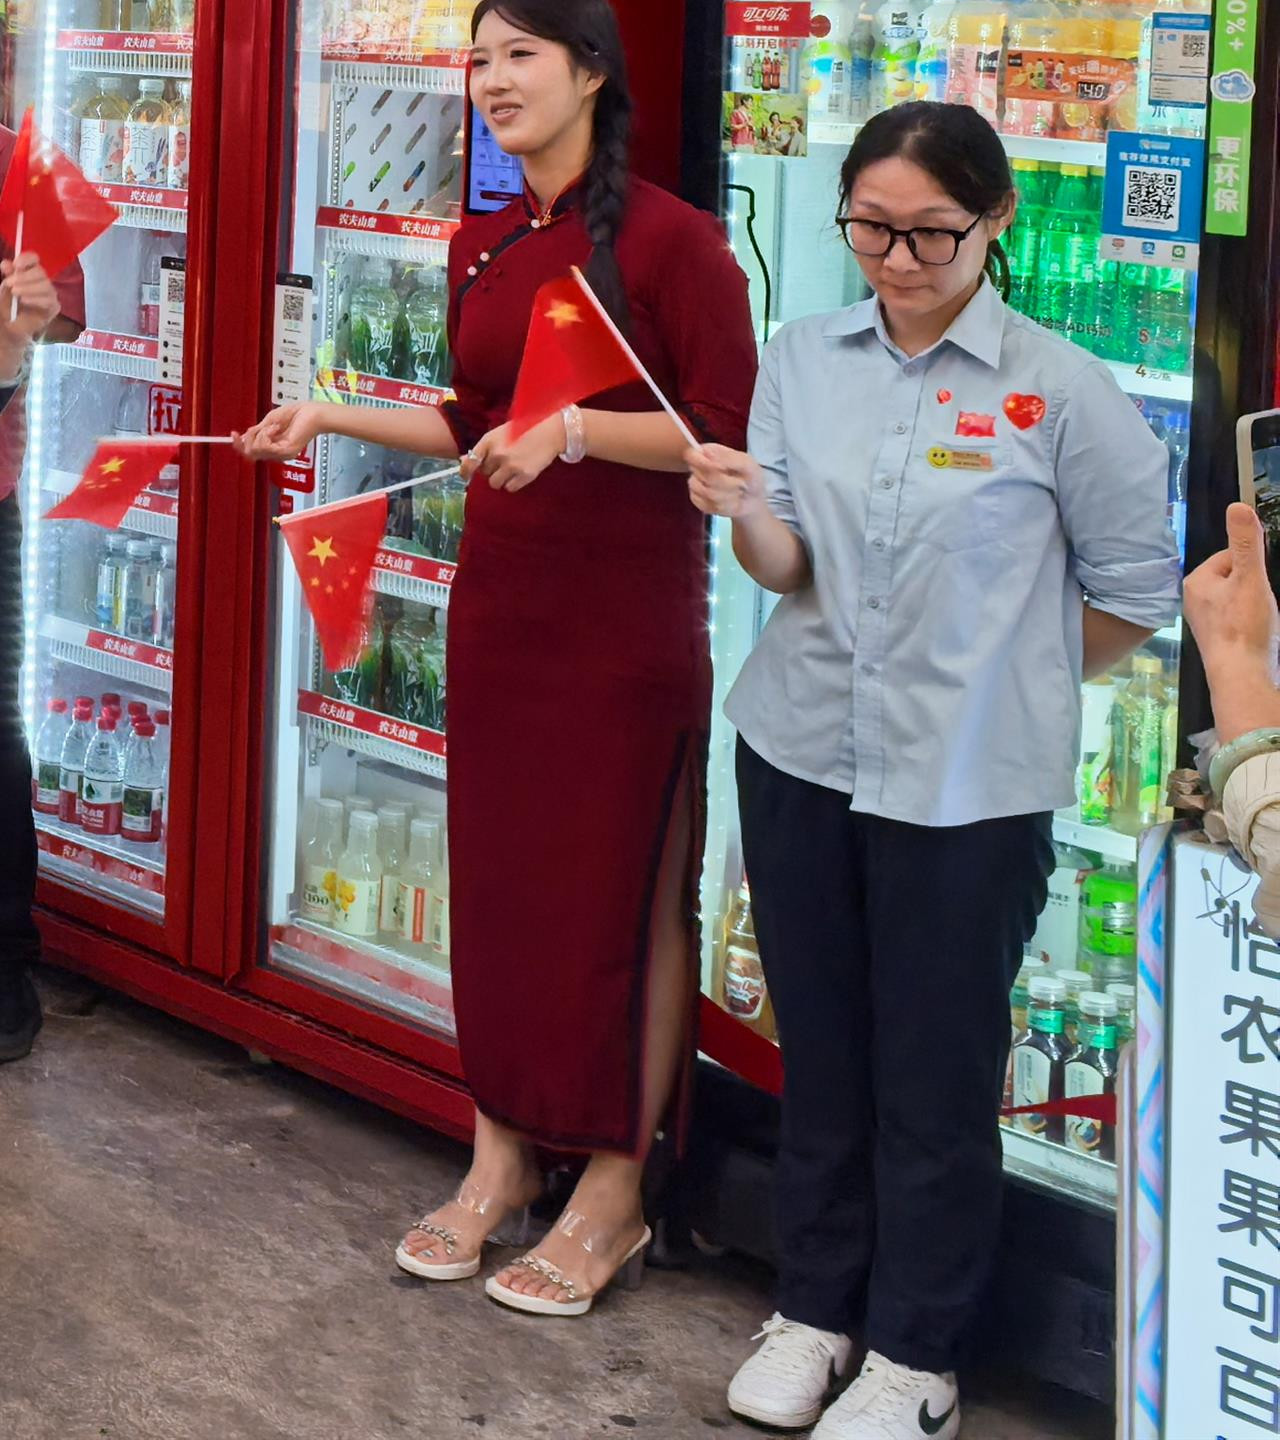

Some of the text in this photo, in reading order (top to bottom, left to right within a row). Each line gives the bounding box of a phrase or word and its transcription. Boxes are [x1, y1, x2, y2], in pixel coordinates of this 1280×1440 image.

[124, 36, 156, 49] 农夫山泉
[1213, 136, 1242, 213] 更环保
[130, 190, 163, 204] 农夫山泉
[339, 212, 441, 236] 农夫山泉 农夫山泉
[113, 337, 146, 354] 农夫山泉
[399, 387, 440, 405] 农夫山泉
[154, 391, 183, 434] 拉
[375, 553, 414, 572] 农夫山泉
[103, 637, 173, 667] 农夫山泉 农夫
[319, 701, 419, 743] 农夫山泉 农夫山泉
